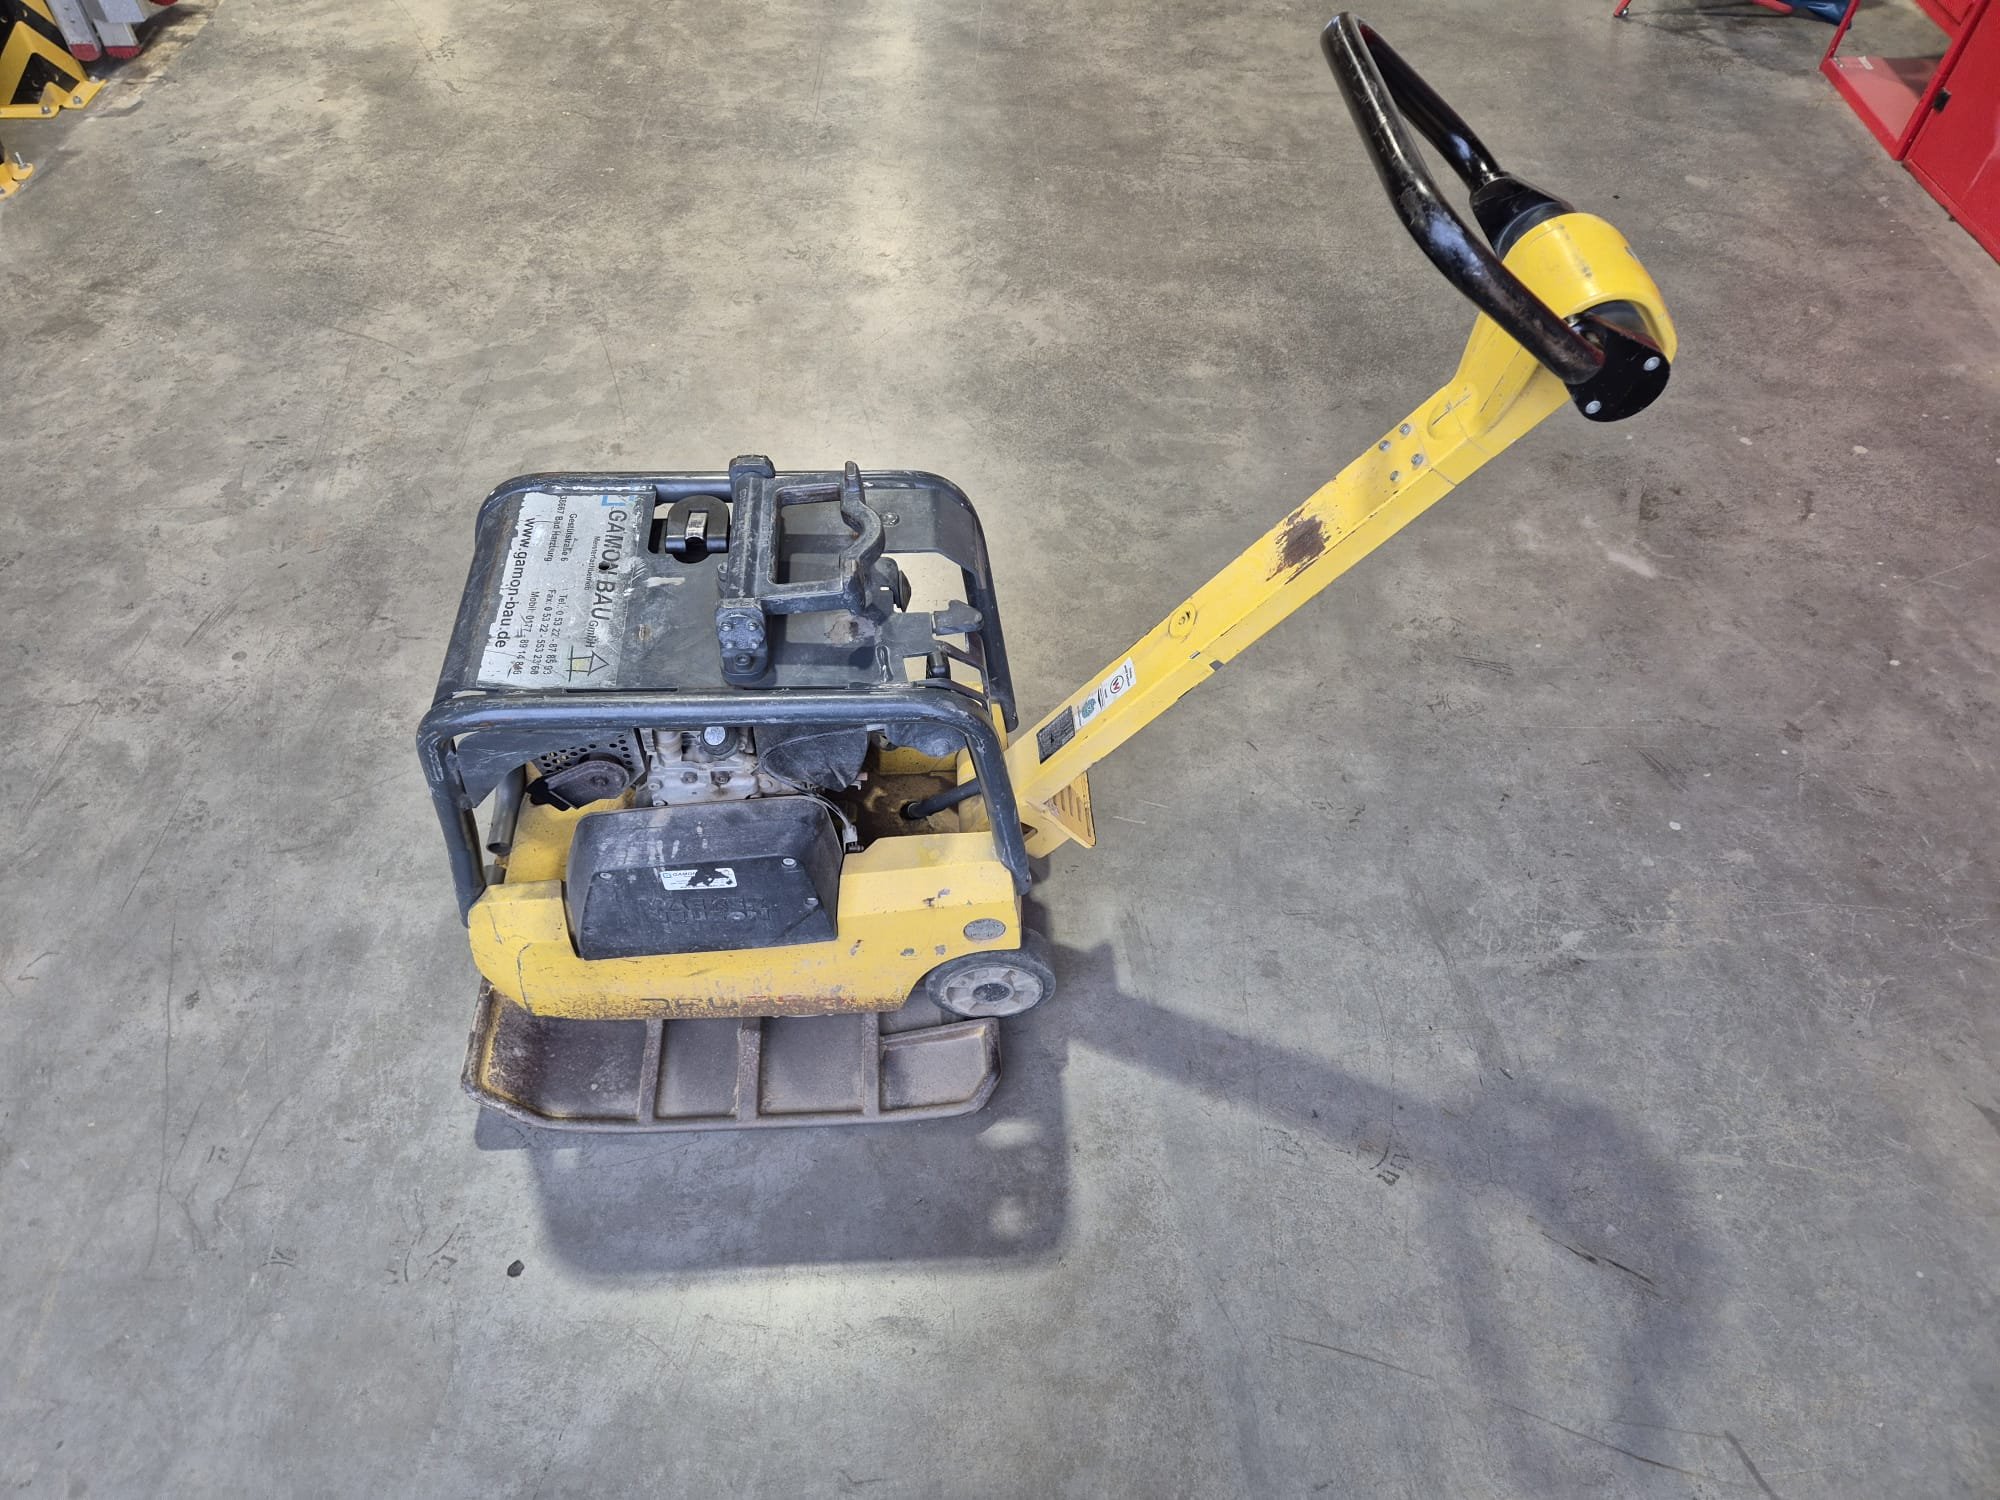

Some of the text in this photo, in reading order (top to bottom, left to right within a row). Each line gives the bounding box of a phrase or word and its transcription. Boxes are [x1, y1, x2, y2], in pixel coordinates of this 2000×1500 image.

[553, 516, 563, 529] Bad
[494, 517, 536, 648] www.gamon-bau.de
[584, 510, 628, 648] GAMON BAU GmbH
[541, 613, 551, 622] 53
[553, 617, 563, 626] 53
[539, 623, 549, 633] 22
[551, 627, 561, 637] 22
[519, 639, 529, 648] 89
[535, 639, 546, 653] 553
[548, 643, 558, 653] 87
[532, 654, 543, 664] 23
[545, 654, 556, 664] 85
